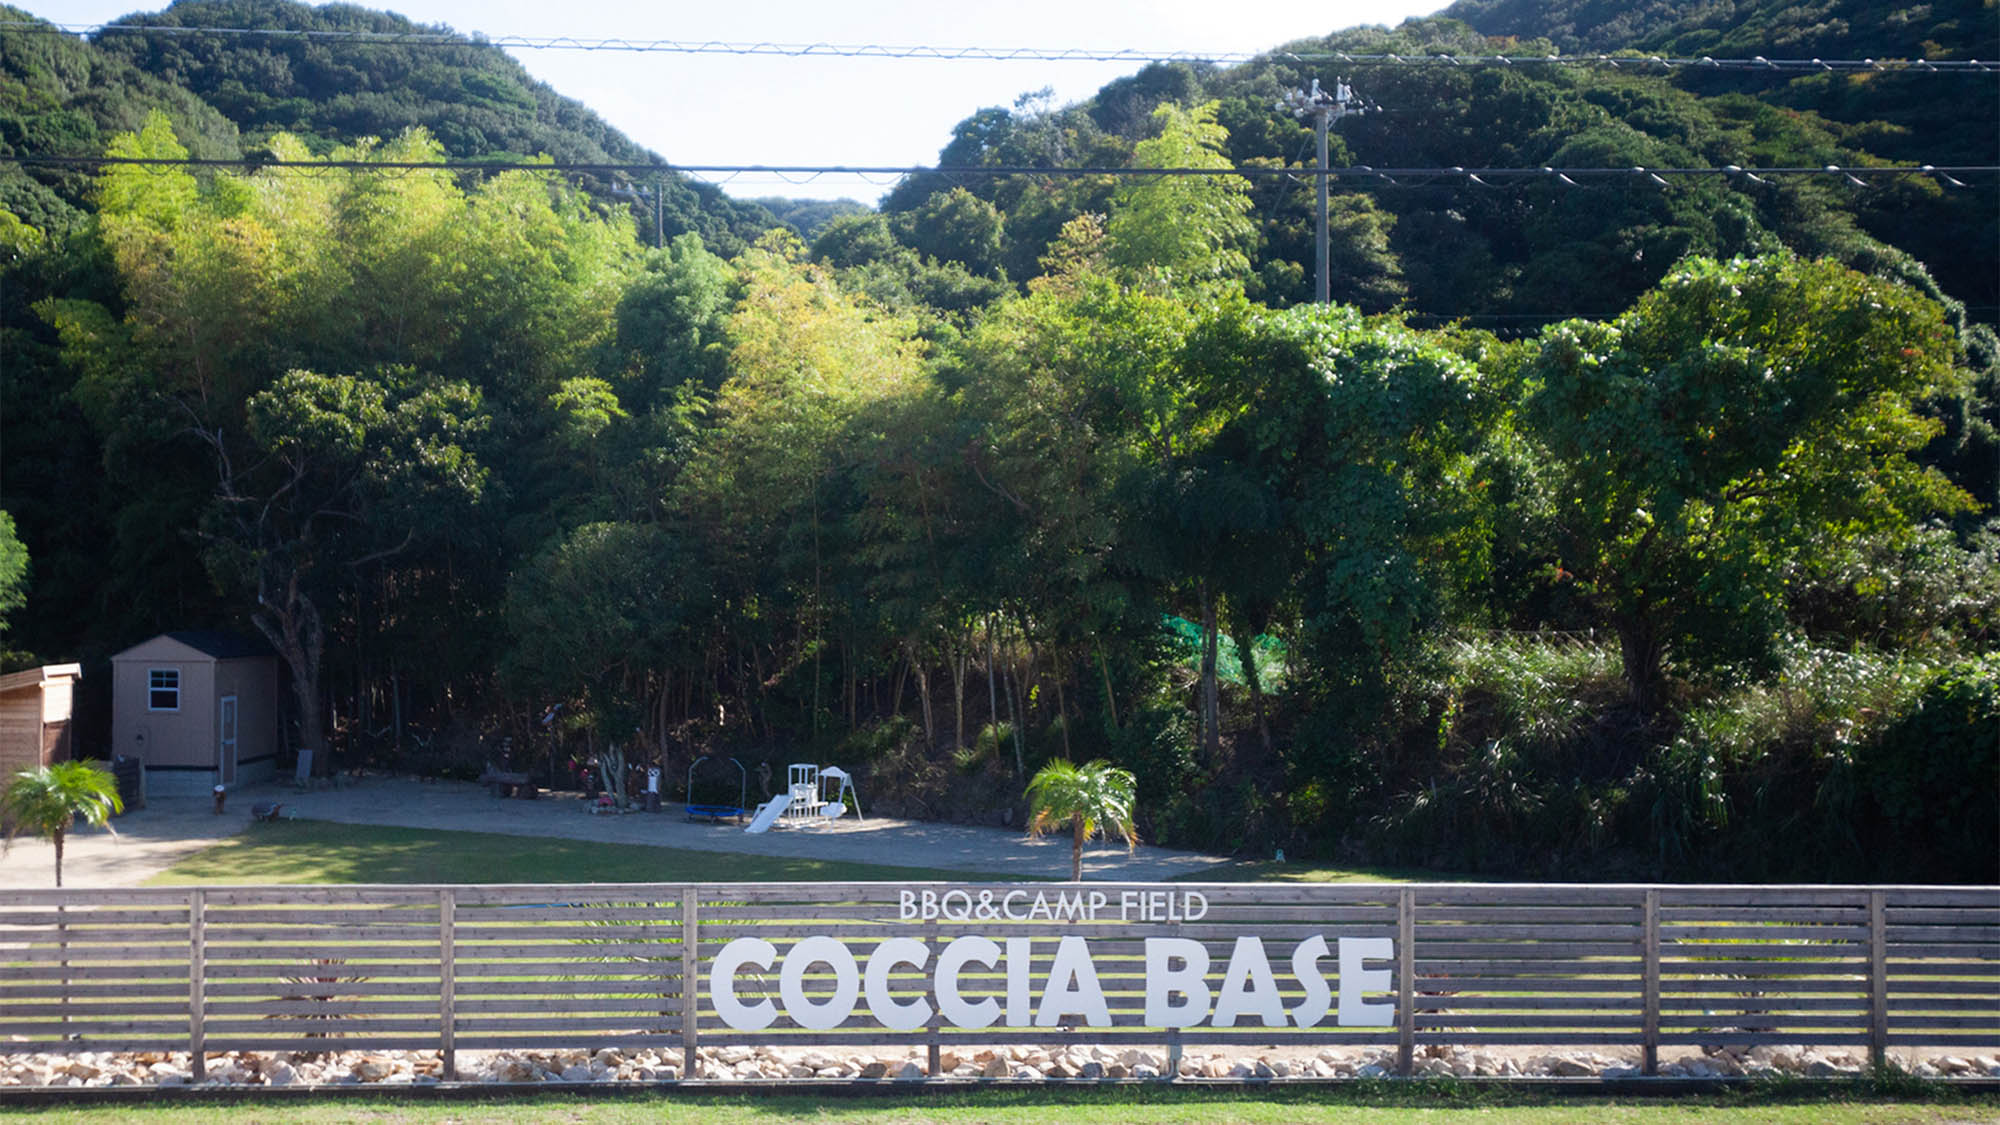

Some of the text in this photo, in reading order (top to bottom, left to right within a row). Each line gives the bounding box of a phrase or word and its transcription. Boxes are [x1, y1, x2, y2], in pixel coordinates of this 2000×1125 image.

[899, 889, 1208, 921] BBQ&CAMP FIELD
[710, 935, 1395, 1030] COCCIA BASE
